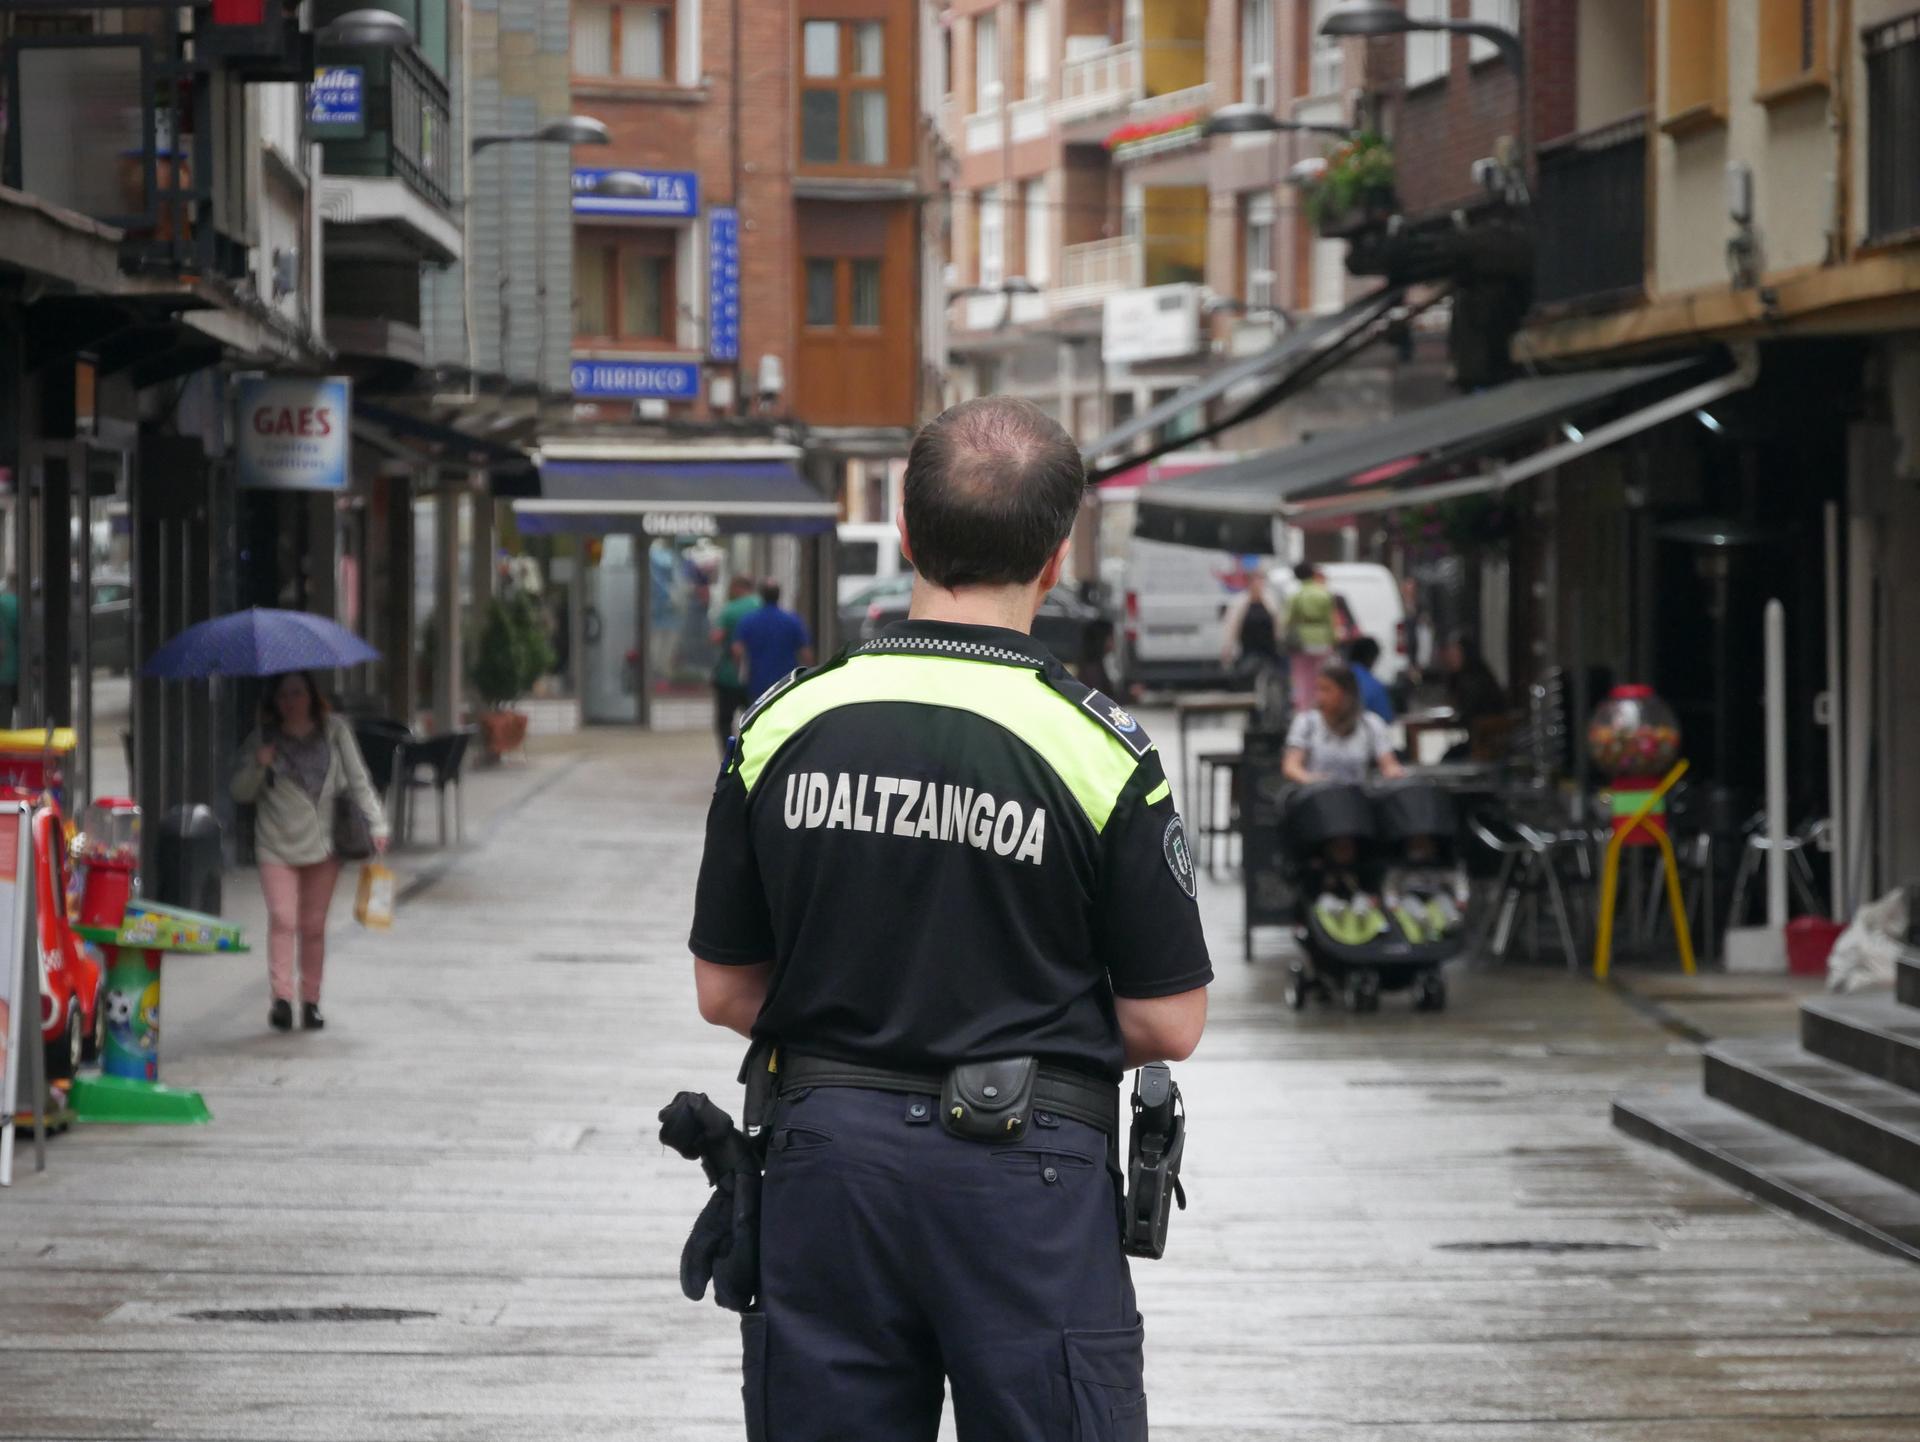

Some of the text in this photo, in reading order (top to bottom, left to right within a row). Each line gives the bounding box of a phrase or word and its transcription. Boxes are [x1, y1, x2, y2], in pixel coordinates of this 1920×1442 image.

[571, 366, 590, 391] O
[253, 406, 331, 437] GAES
[784, 772, 1046, 866] UDALTZAINGOA
